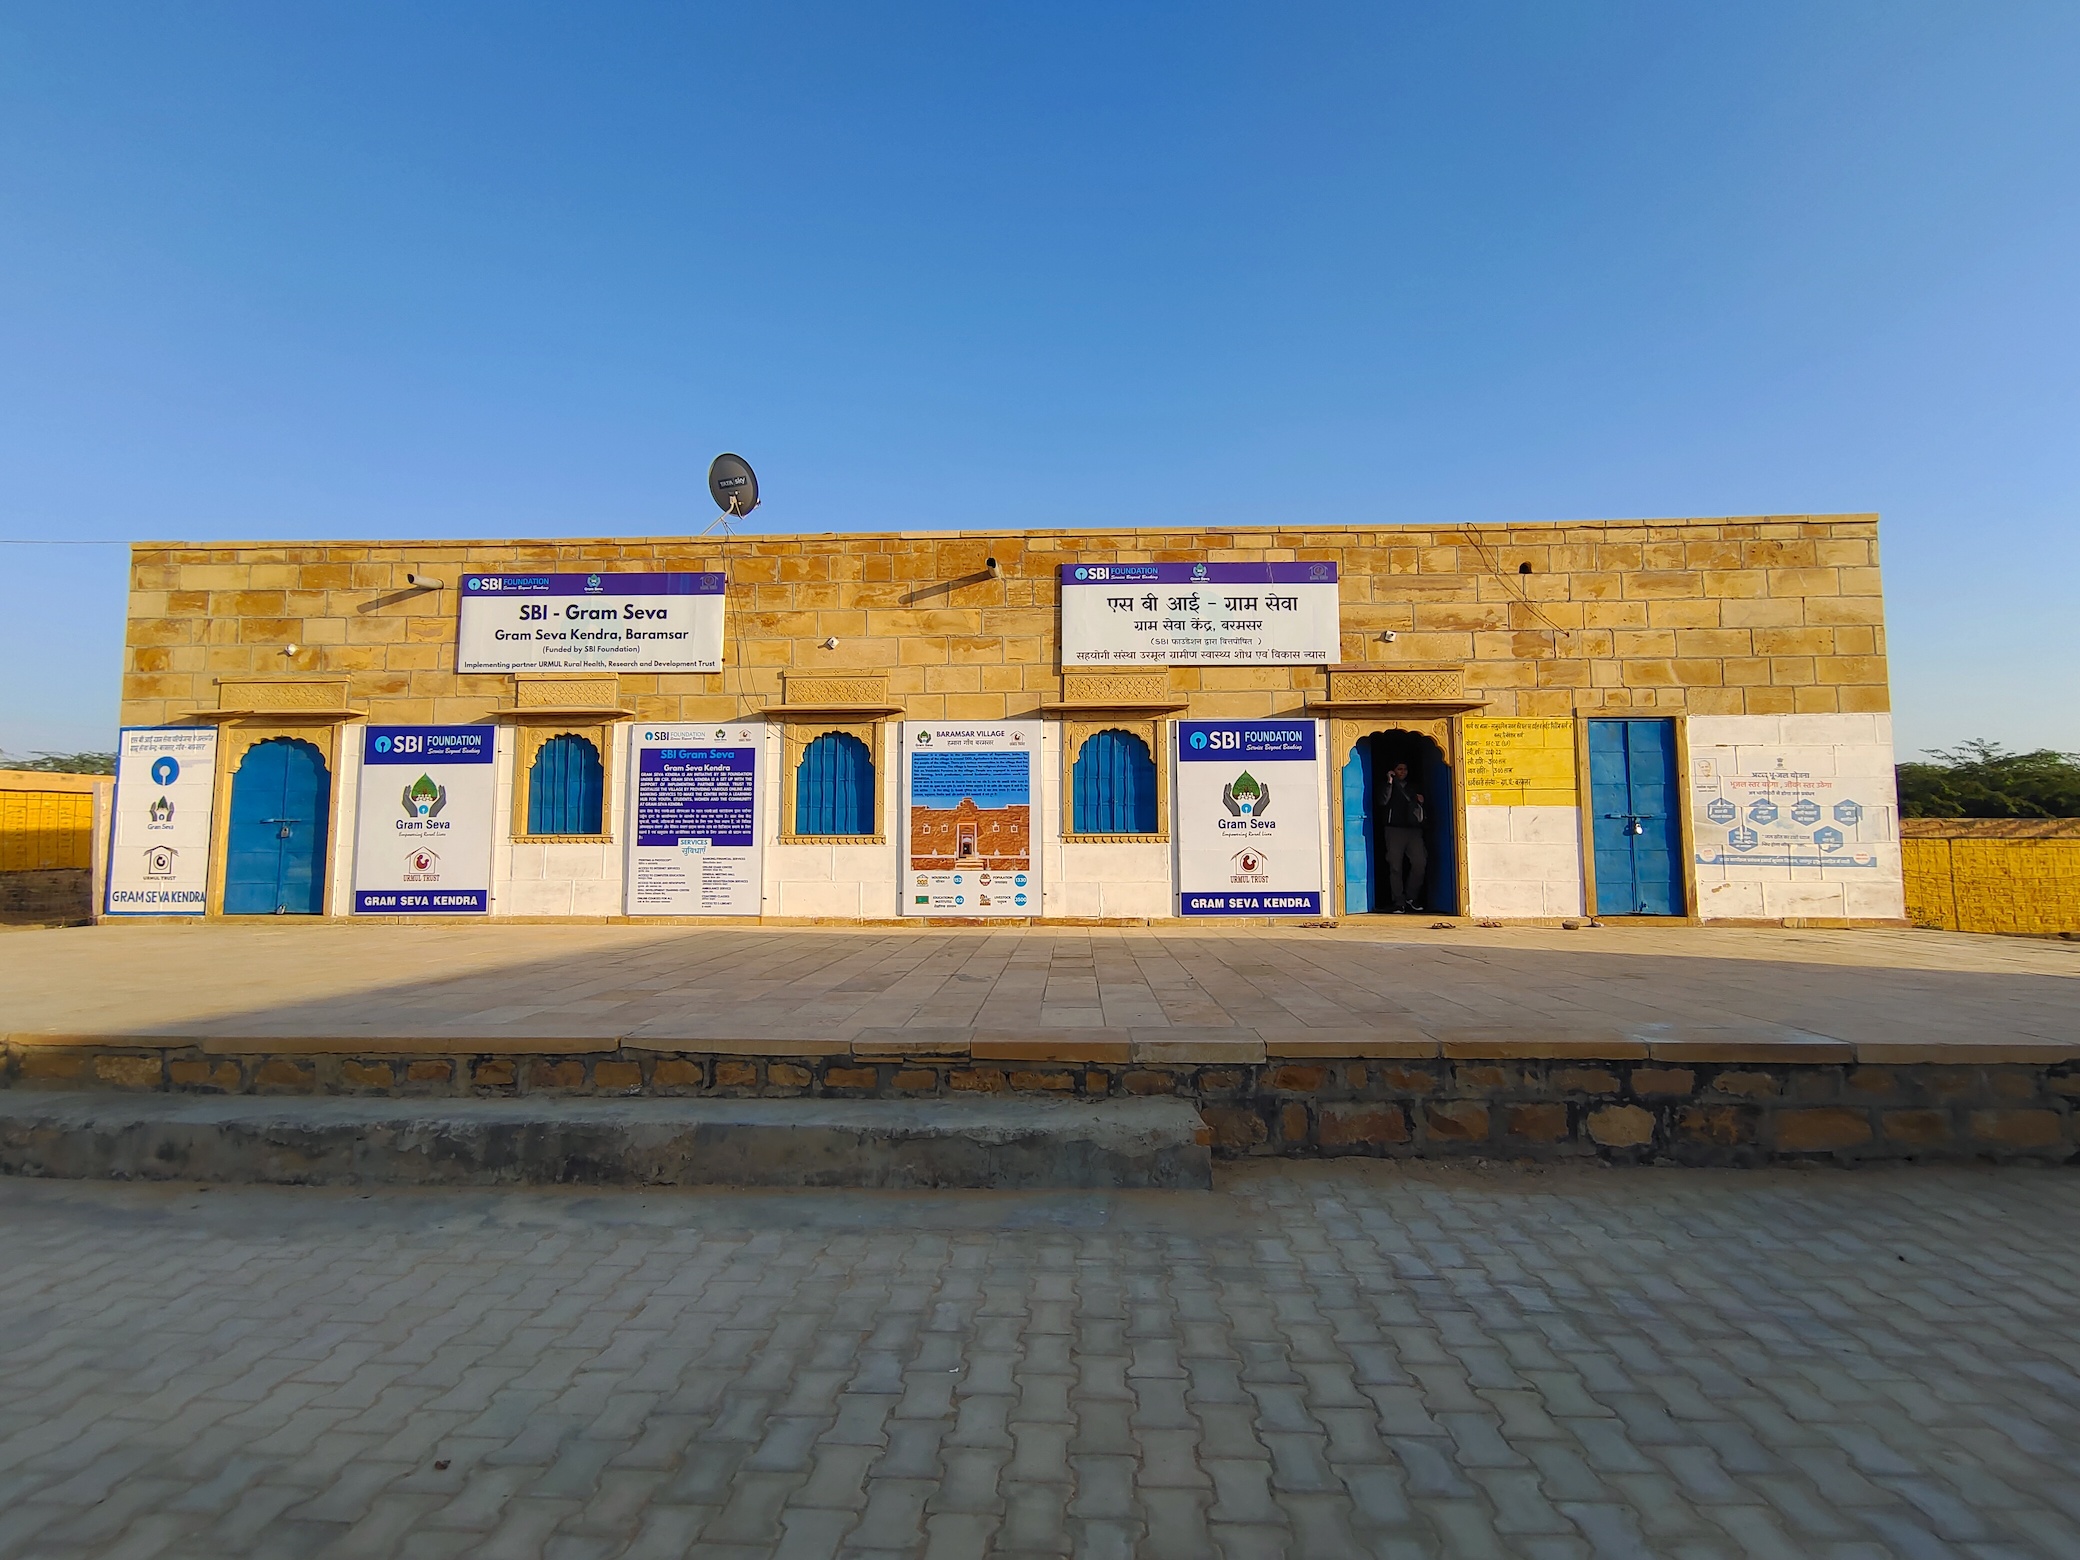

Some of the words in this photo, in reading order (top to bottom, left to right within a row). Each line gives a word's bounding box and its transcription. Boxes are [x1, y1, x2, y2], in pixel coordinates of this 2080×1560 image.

[1088, 568, 1110, 580] SBI
[480, 578, 502, 590] SBI
[1107, 598, 1134, 612] एस
[1140, 592, 1158, 611] बी
[1166, 592, 1200, 614] आई
[1224, 597, 1258, 611] ग्राम
[1264, 593, 1298, 611] सेवा
[519, 604, 548, 620] SBI
[566, 604, 617, 620] Gram
[624, 604, 668, 620] Seva
[1134, 620, 1158, 630] ग्राम
[1163, 618, 1186, 630] सेवा
[1220, 620, 1262, 630] बरमसर
[495, 629, 530, 640] Gram
[536, 628, 566, 640] Seva
[570, 628, 622, 641] Kendra,
[626, 628, 689, 640] Baramsar
[542, 646, 572, 654] (Funded
[574, 646, 582, 654] by
[597, 645, 640, 654] Foundation)
[1076, 650, 1110, 661] सहयोगी
[1113, 650, 1136, 660] संस्था
[1140, 652, 1166, 662] उरमूल
[1169, 649, 1198, 660] ग्रामीण
[1200, 651, 1230, 660] स्वास्थ्य
[1234, 649, 1252, 659] शोध
[1272, 649, 1300, 659] विकास
[1303, 651, 1326, 659] न्यास
[464, 661, 510, 669] Implementing
[654, 732, 669, 740] SBI
[1210, 731, 1240, 749] SBI
[1244, 730, 1302, 742] FOUNDATION
[393, 736, 423, 753] SBI
[427, 735, 482, 746] FOUNDATION
[660, 750, 676, 759] SBI
[679, 750, 708, 759] Gram
[710, 750, 734, 758] Seva
[396, 819, 422, 829] Gram
[426, 819, 450, 829] Seva
[1218, 818, 1247, 829] Gram
[1250, 818, 1276, 829] Seva
[112, 891, 144, 902] GRAM
[146, 891, 170, 902] SEVA
[171, 890, 205, 902] KENDRA
[364, 896, 396, 906] GRAM
[400, 896, 429, 906] SEVA
[433, 896, 478, 906] KENDRA
[1191, 898, 1224, 908] GRAM
[1228, 898, 1259, 908] SEVA
[1263, 898, 1311, 908] KENDRA
